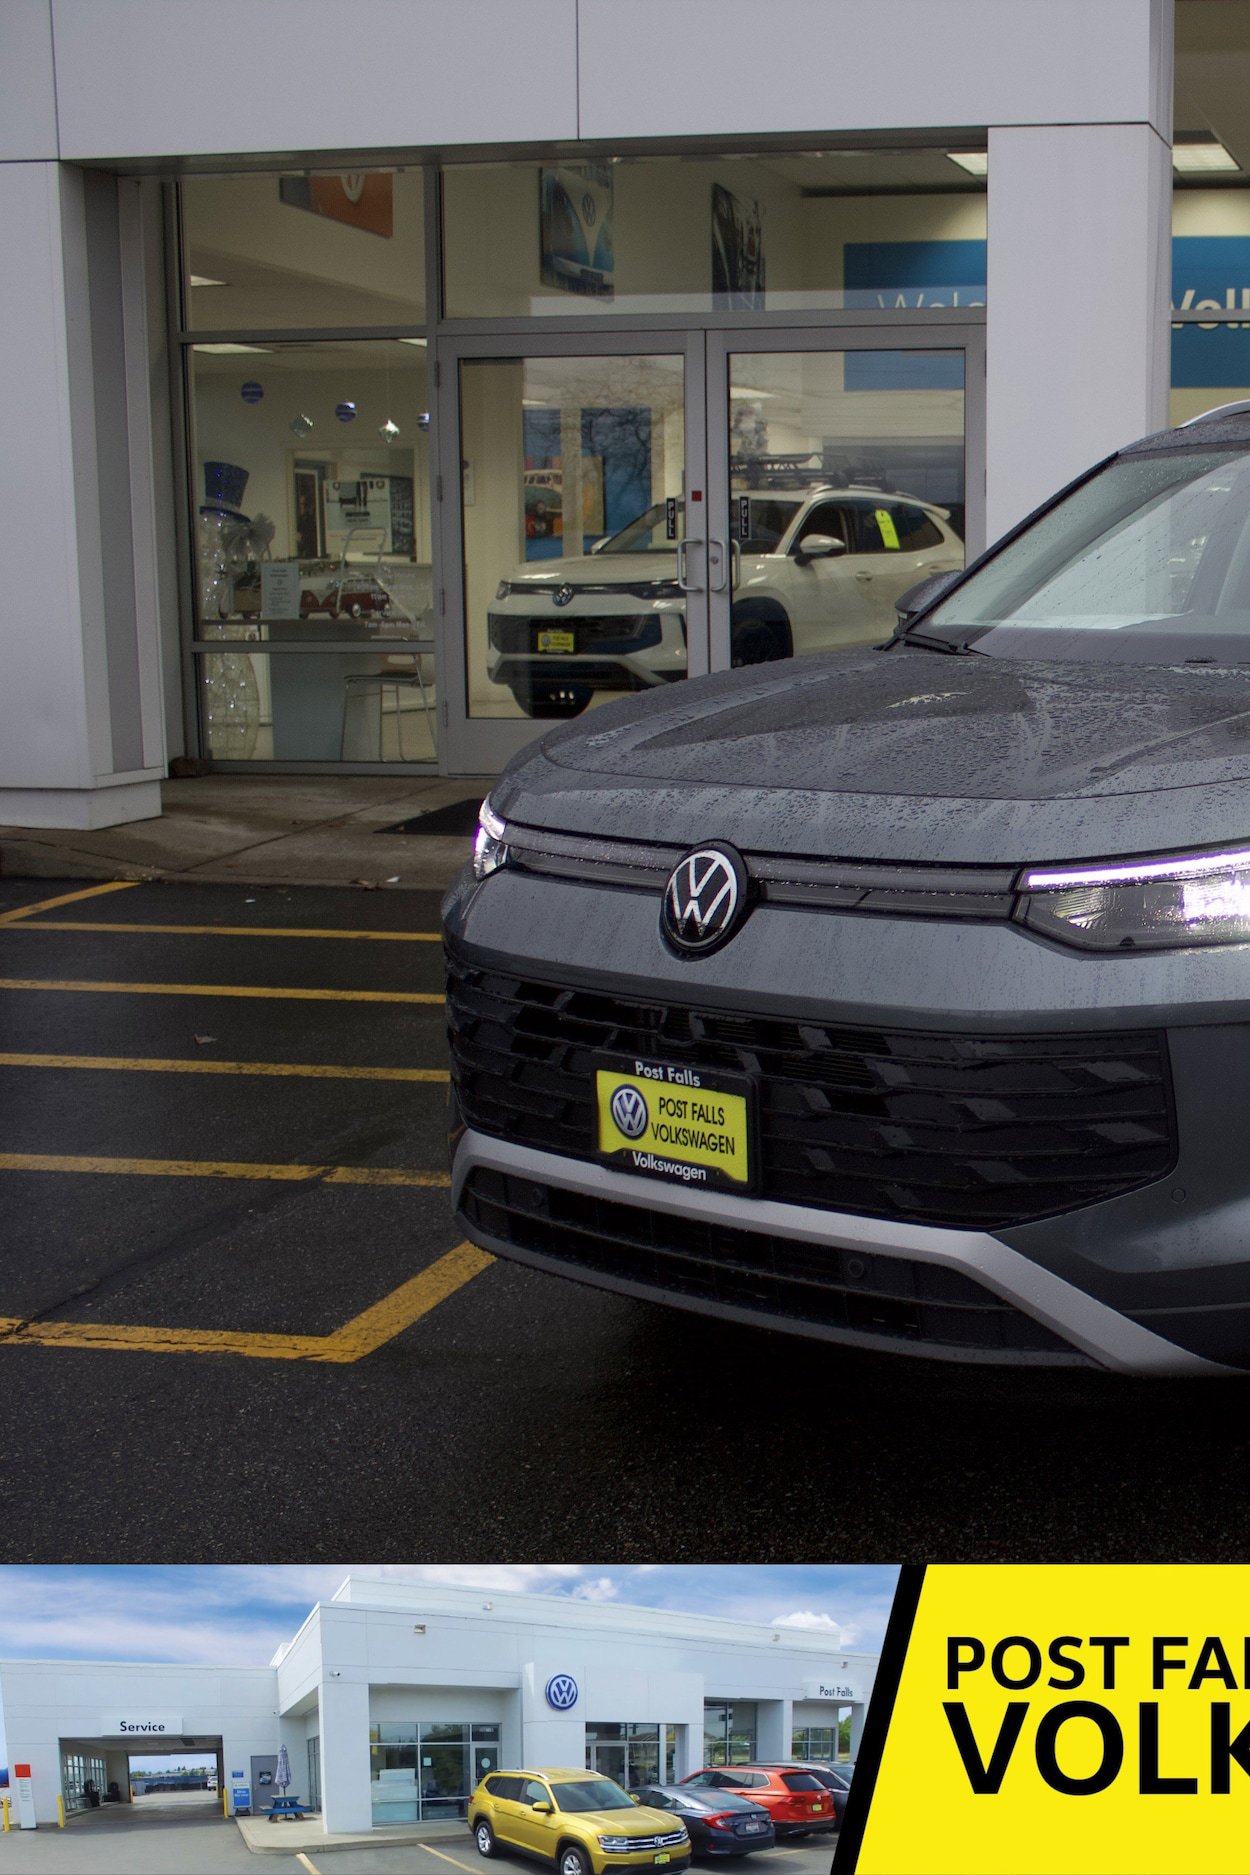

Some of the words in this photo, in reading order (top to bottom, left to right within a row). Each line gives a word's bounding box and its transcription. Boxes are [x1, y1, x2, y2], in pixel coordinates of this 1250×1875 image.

[667, 501, 675, 537] PULL
[740, 500, 748, 536] PULL
[664, 849, 737, 947] VW
[635, 1061, 664, 1081] Post
[667, 1066, 701, 1088] Falls
[610, 1084, 649, 1141] VW
[659, 1097, 688, 1120] POST
[691, 1102, 726, 1127] FALLS
[651, 1122, 735, 1155] VOLKSWAGEN
[632, 1151, 707, 1181] Volkswagen
